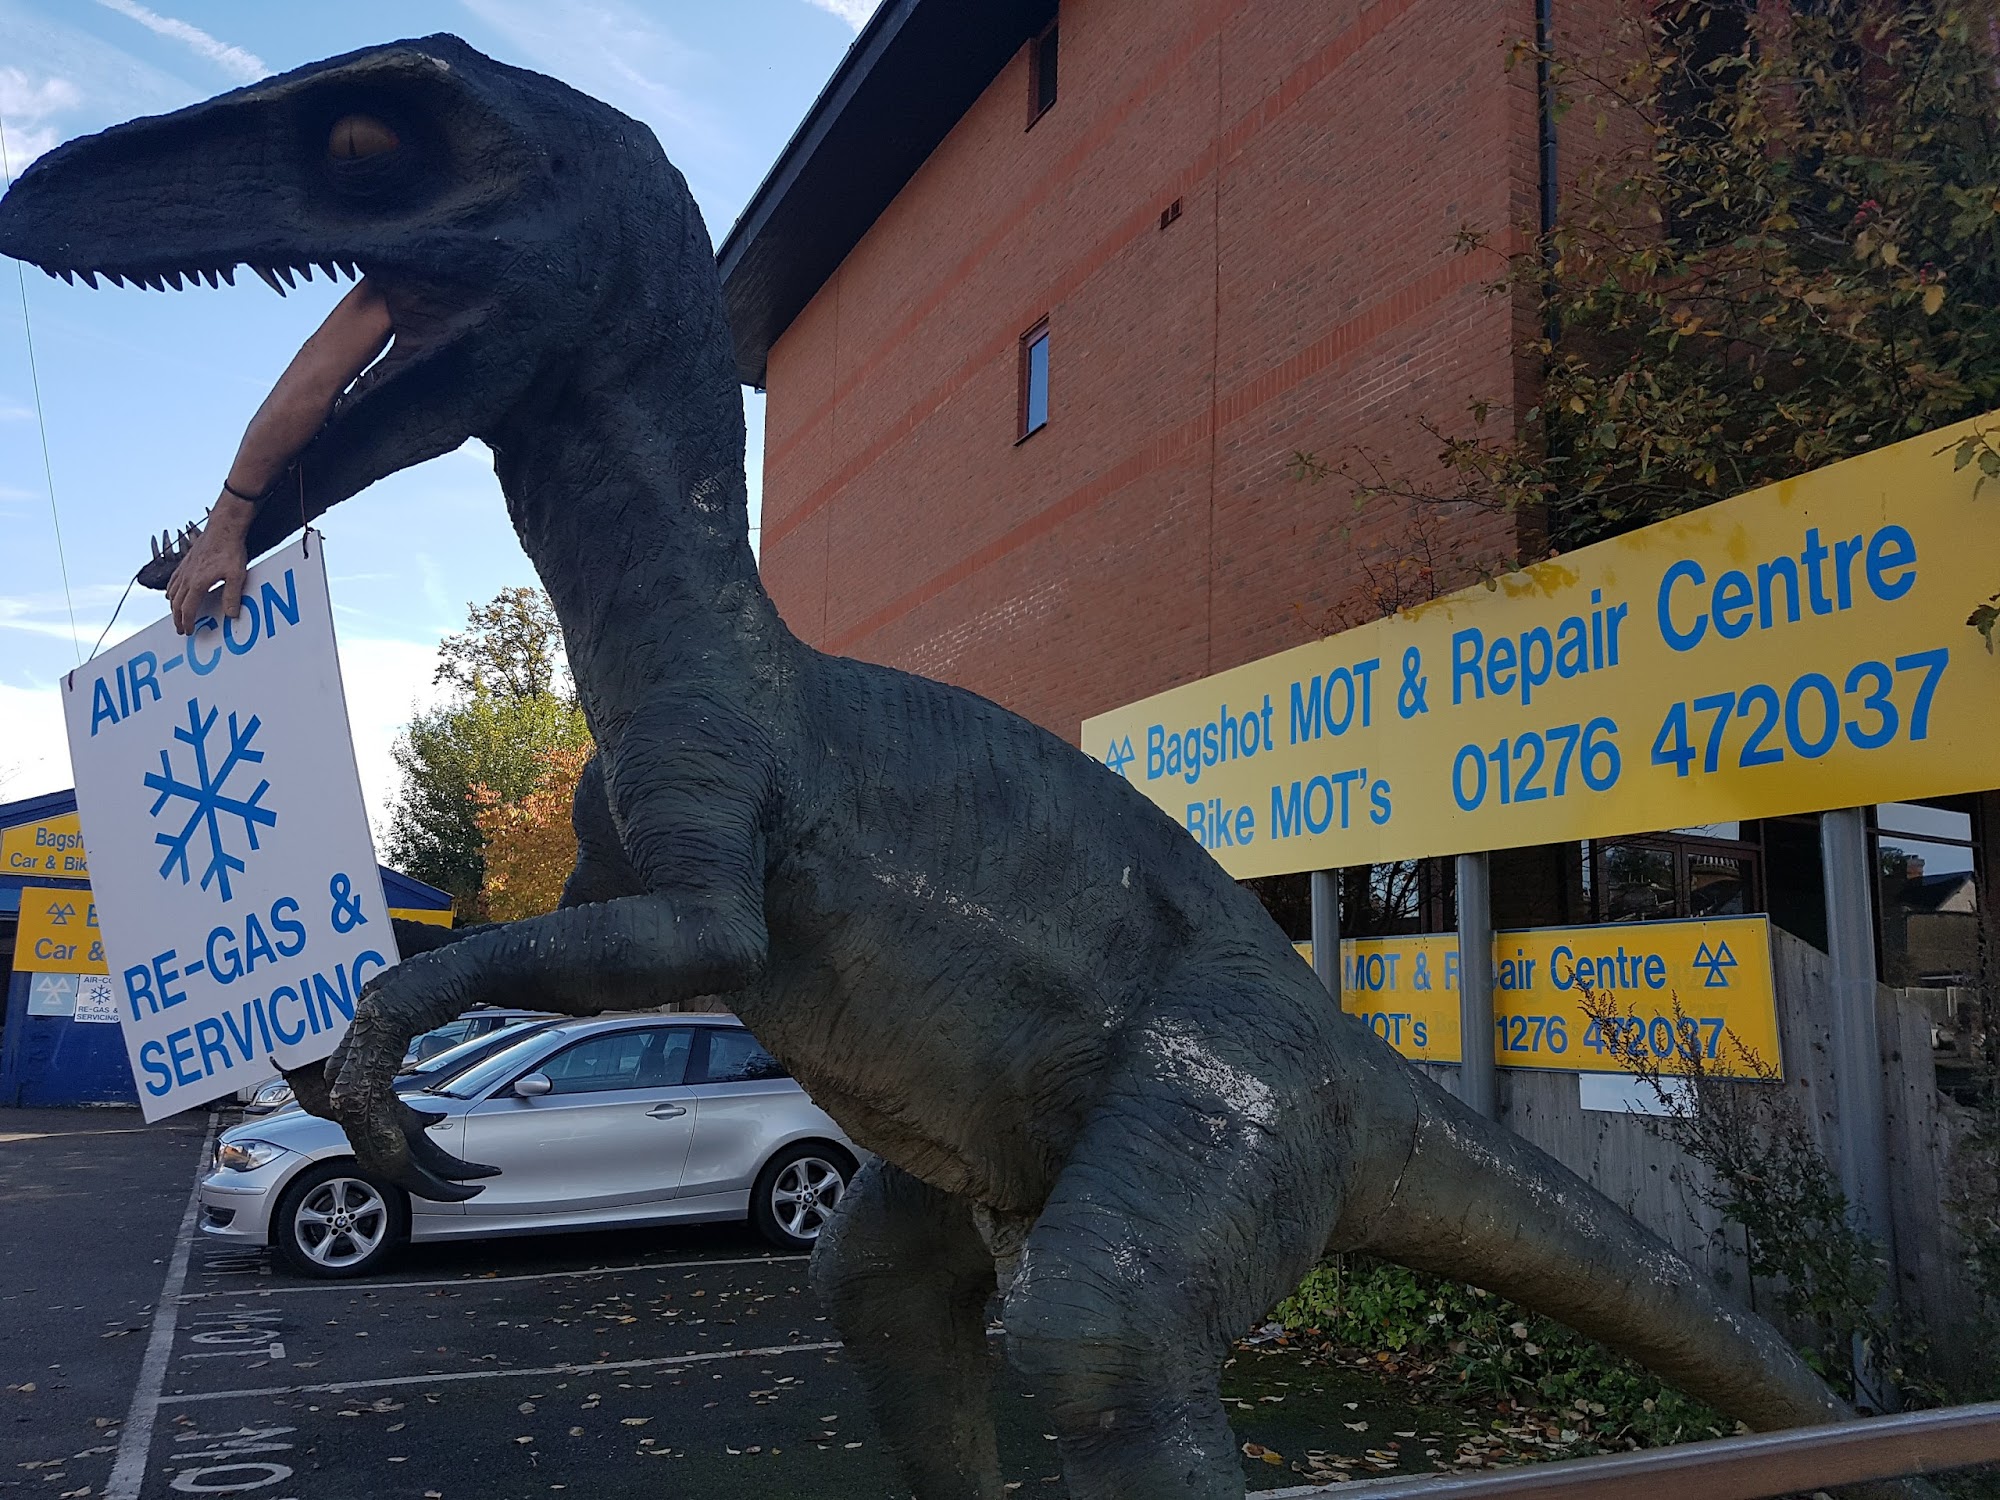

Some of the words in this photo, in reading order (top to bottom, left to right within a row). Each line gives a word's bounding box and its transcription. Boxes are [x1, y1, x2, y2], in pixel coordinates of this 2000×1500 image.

[91, 568, 300, 738] AIR-CON
[1147, 694, 1273, 785] Bagshot
[1290, 658, 1380, 746] MOT
[1398, 646, 1429, 719] &
[1452, 590, 1628, 706] Repair
[1657, 525, 1918, 652] Centre
[1452, 717, 1621, 812] 01276
[1651, 648, 1950, 778] 472037
[1186, 798, 1255, 850] Bike
[1271, 768, 1392, 840] MOT's
[10, 852, 38, 868] Car
[45, 855, 56, 870] &
[34, 938, 77, 960] Car
[88, 941, 104, 961] &
[83, 976, 112, 984] AIR-C
[124, 896, 306, 1022] RE-GAS
[330, 872, 368, 934] &
[1344, 953, 1400, 991] MOT
[1413, 952, 1431, 990] &
[1445, 949, 1536, 991] Rair
[1550, 945, 1666, 991] Centre
